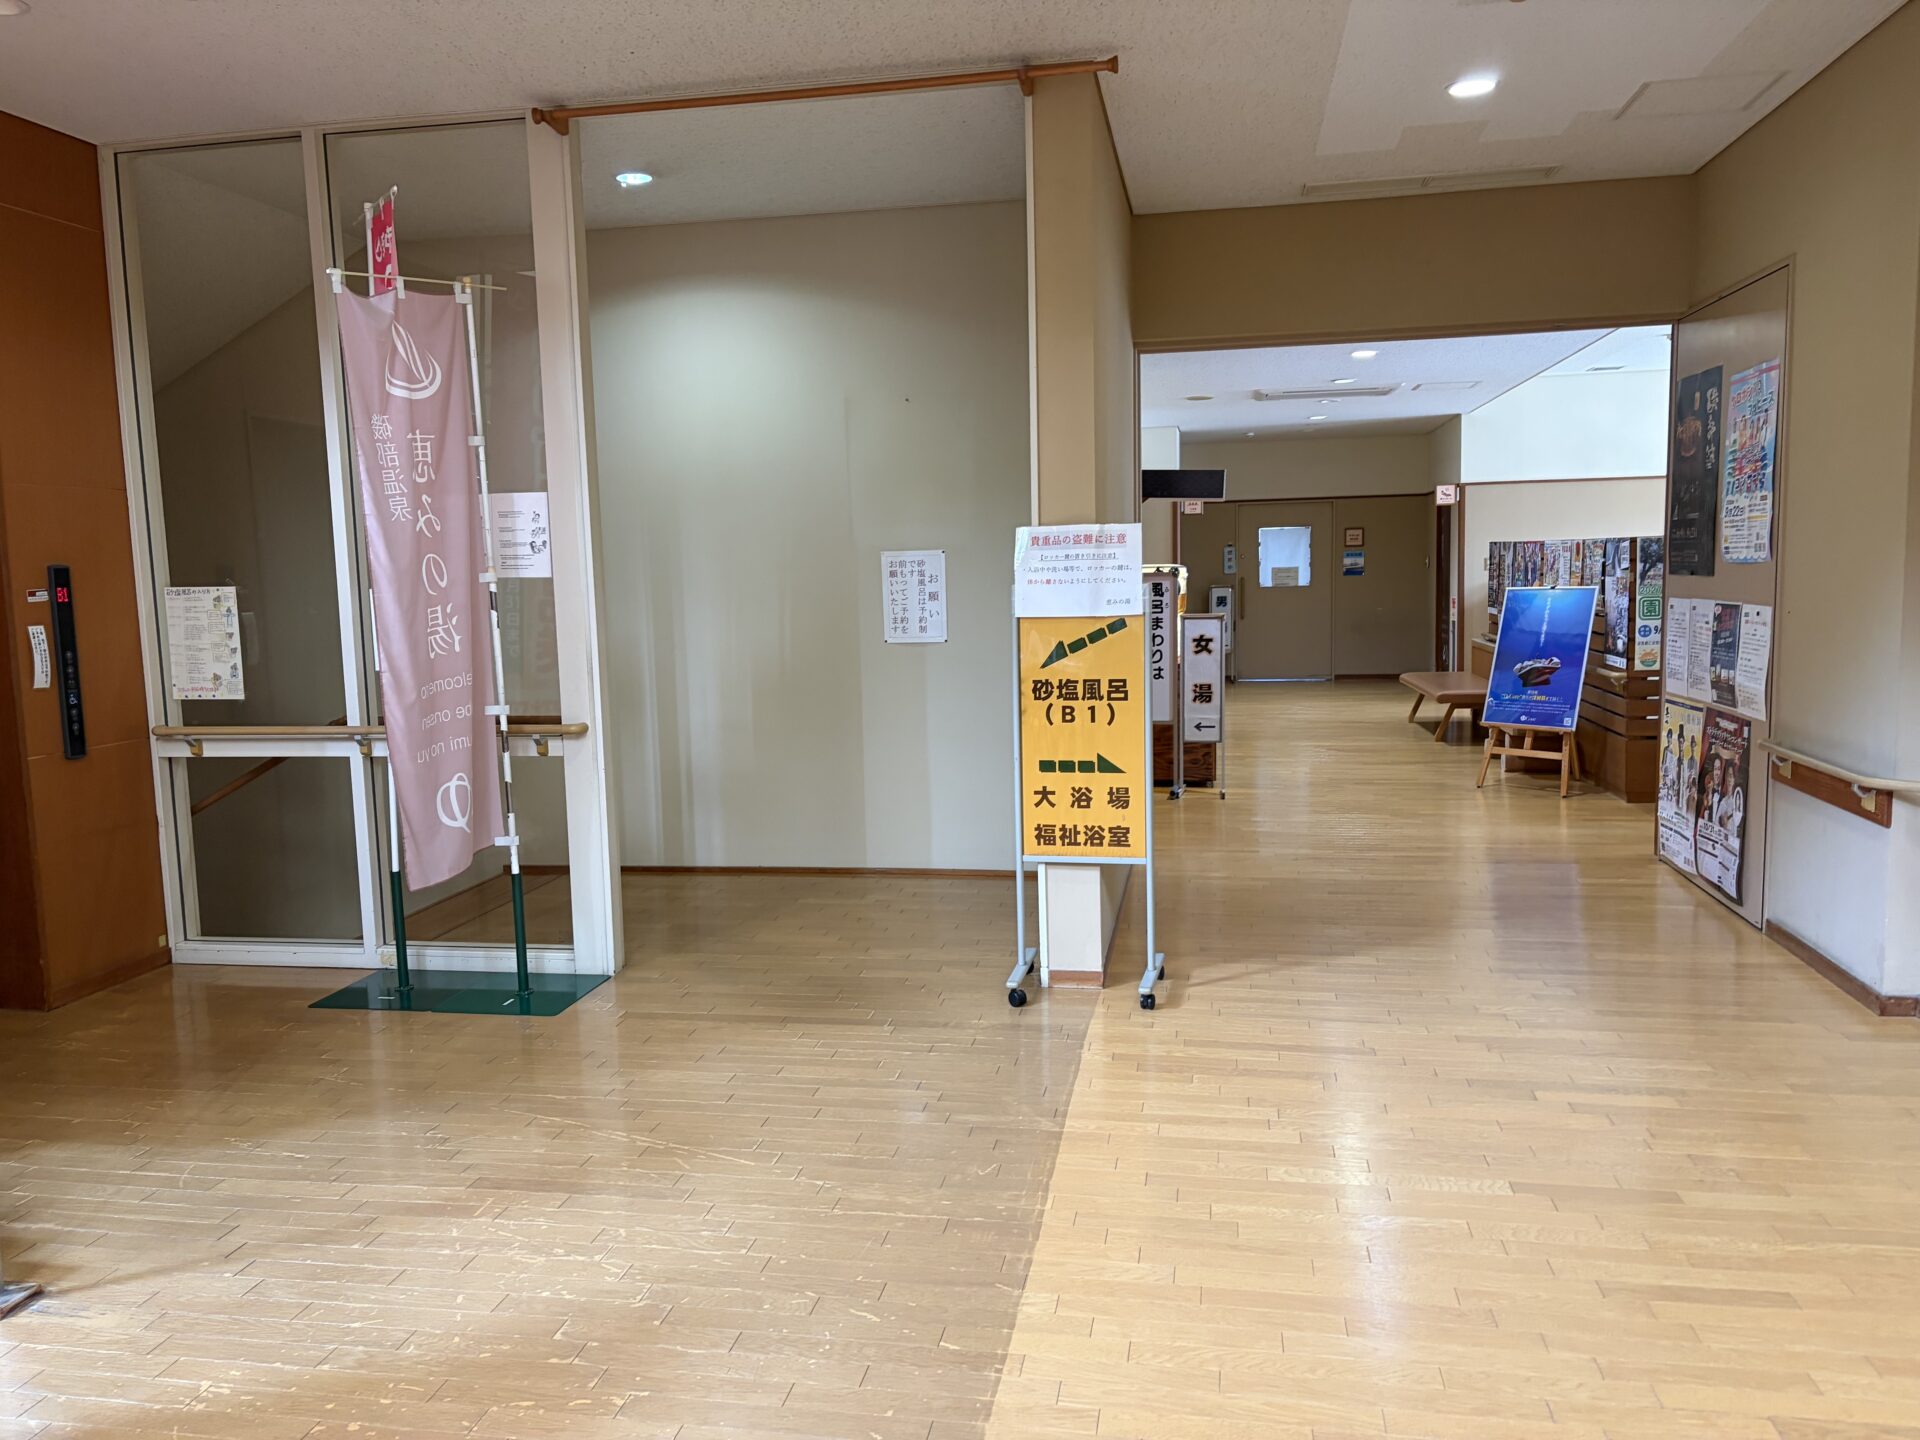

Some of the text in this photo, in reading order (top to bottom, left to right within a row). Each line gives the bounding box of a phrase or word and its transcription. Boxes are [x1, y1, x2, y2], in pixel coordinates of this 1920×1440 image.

[1030, 533, 1127, 547] 貴重品の盗難に注意
[908, 561, 916, 578] です
[56, 587, 69, 602] B1
[889, 560, 900, 634] お願いいたします
[898, 560, 909, 634] 前もってご予約を
[917, 560, 927, 634] 砂塩風呂は予約制
[928, 573, 939, 618] お願い
[1191, 634, 1214, 704] 女湯
[1031, 678, 1129, 702] 砂塩風呂
[1033, 786, 1130, 810] 大浴場
[1034, 824, 1131, 848] 福祉浴室
